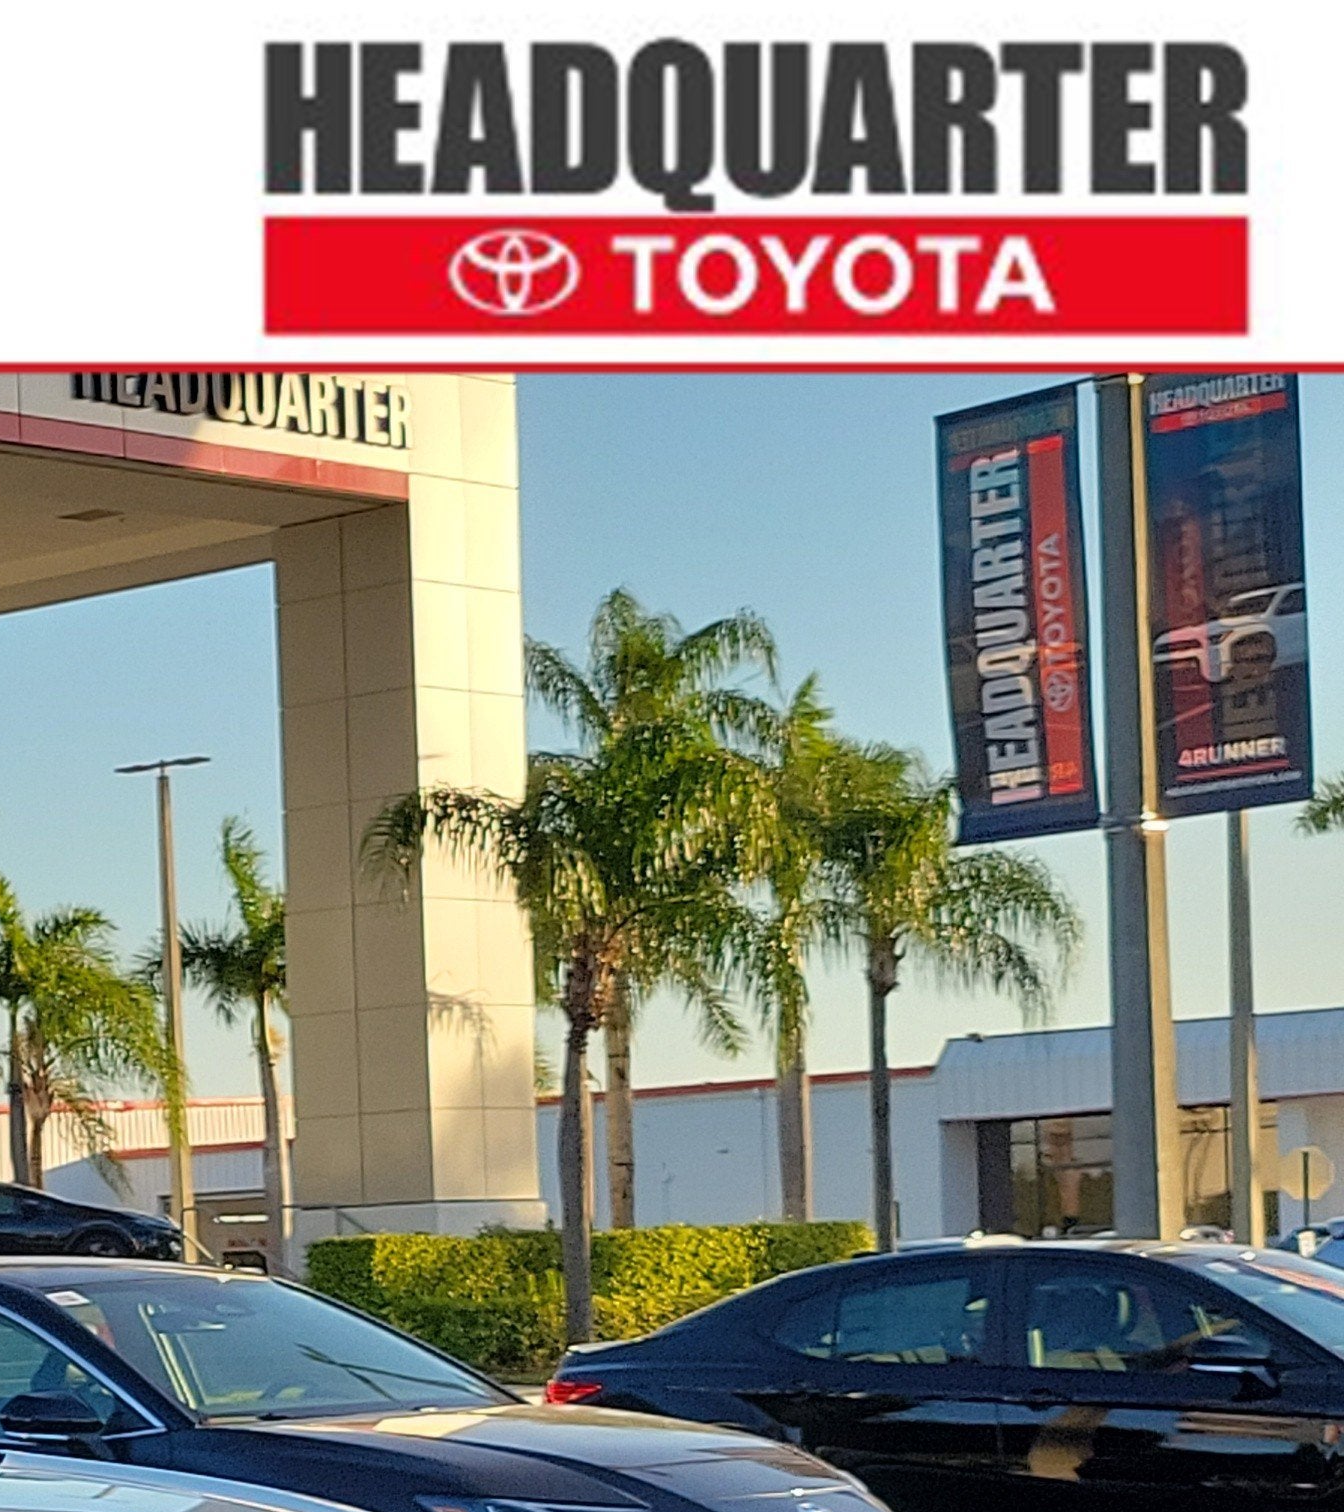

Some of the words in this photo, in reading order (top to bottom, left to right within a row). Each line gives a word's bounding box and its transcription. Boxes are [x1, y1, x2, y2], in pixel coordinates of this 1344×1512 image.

[1150, 374, 1286, 415] HEADQUARTER
[970, 448, 1043, 805] HEADQUARTER
[1038, 533, 1073, 668] TOYOTA
[1178, 737, 1286, 767] 4RUNNER
